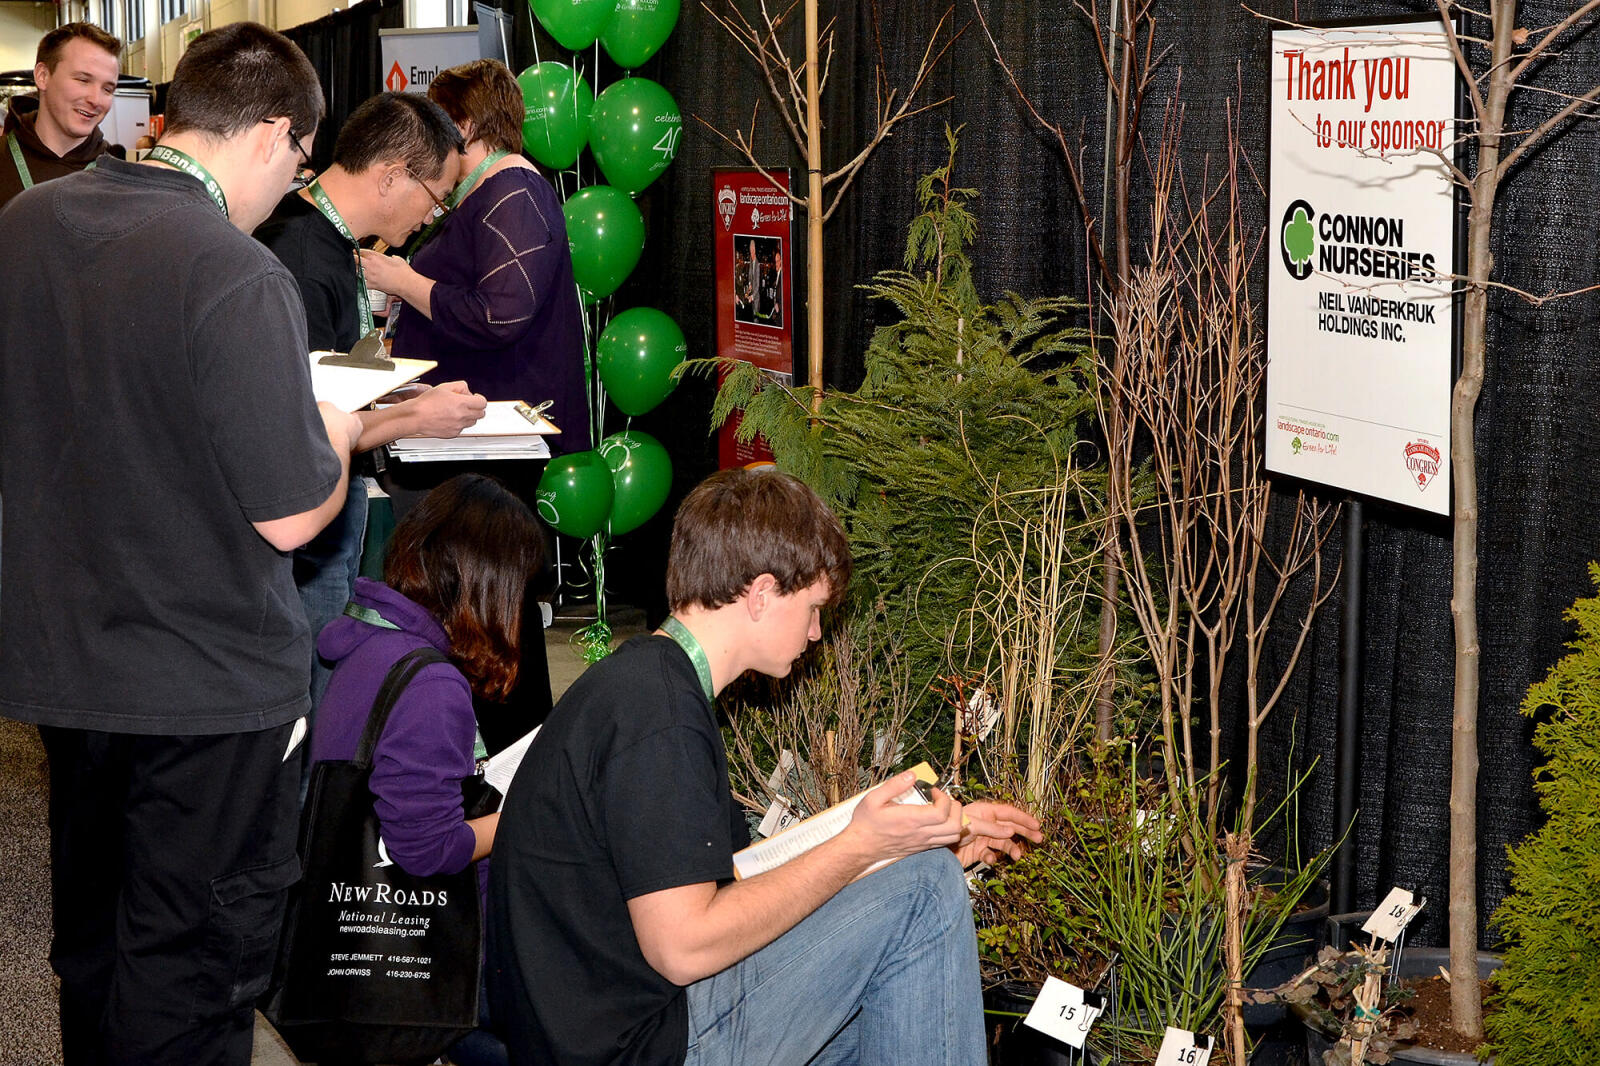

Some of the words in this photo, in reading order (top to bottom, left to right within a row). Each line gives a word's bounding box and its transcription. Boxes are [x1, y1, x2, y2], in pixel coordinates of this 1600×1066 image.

[1284, 47, 1357, 101] Thank
[1364, 57, 1410, 113] you
[1316, 113, 1332, 149] to
[1337, 119, 1366, 149] our
[1370, 119, 1446, 157] sponsor
[320, 197, 347, 235] Stones
[1319, 213, 1404, 248] CONNON
[1319, 244, 1437, 284] NURSERIES
[1319, 291, 1346, 313] NEIL
[1347, 295, 1436, 324] VANDERKRUK
[1318, 313, 1379, 339] HOLDINGS
[1381, 321, 1406, 343] INC.
[1406, 456, 1439, 476] CONGRESS
[373, 882, 449, 907] ROADS
[337, 910, 386, 922] National
[389, 912, 431, 929] Leasing
[1388, 904, 1406, 918] 18
[339, 924, 426, 938] newroadsleasing.com
[330, 953, 349, 962] STEVE
[350, 953, 384, 962] JEMMETT
[327, 968, 345, 977] JOHN
[345, 968, 372, 977] ORVISS
[386, 970, 431, 980] 416-230-6735
[1058, 1004, 1077, 1022] 15
[1177, 1048, 1197, 1064] 16
